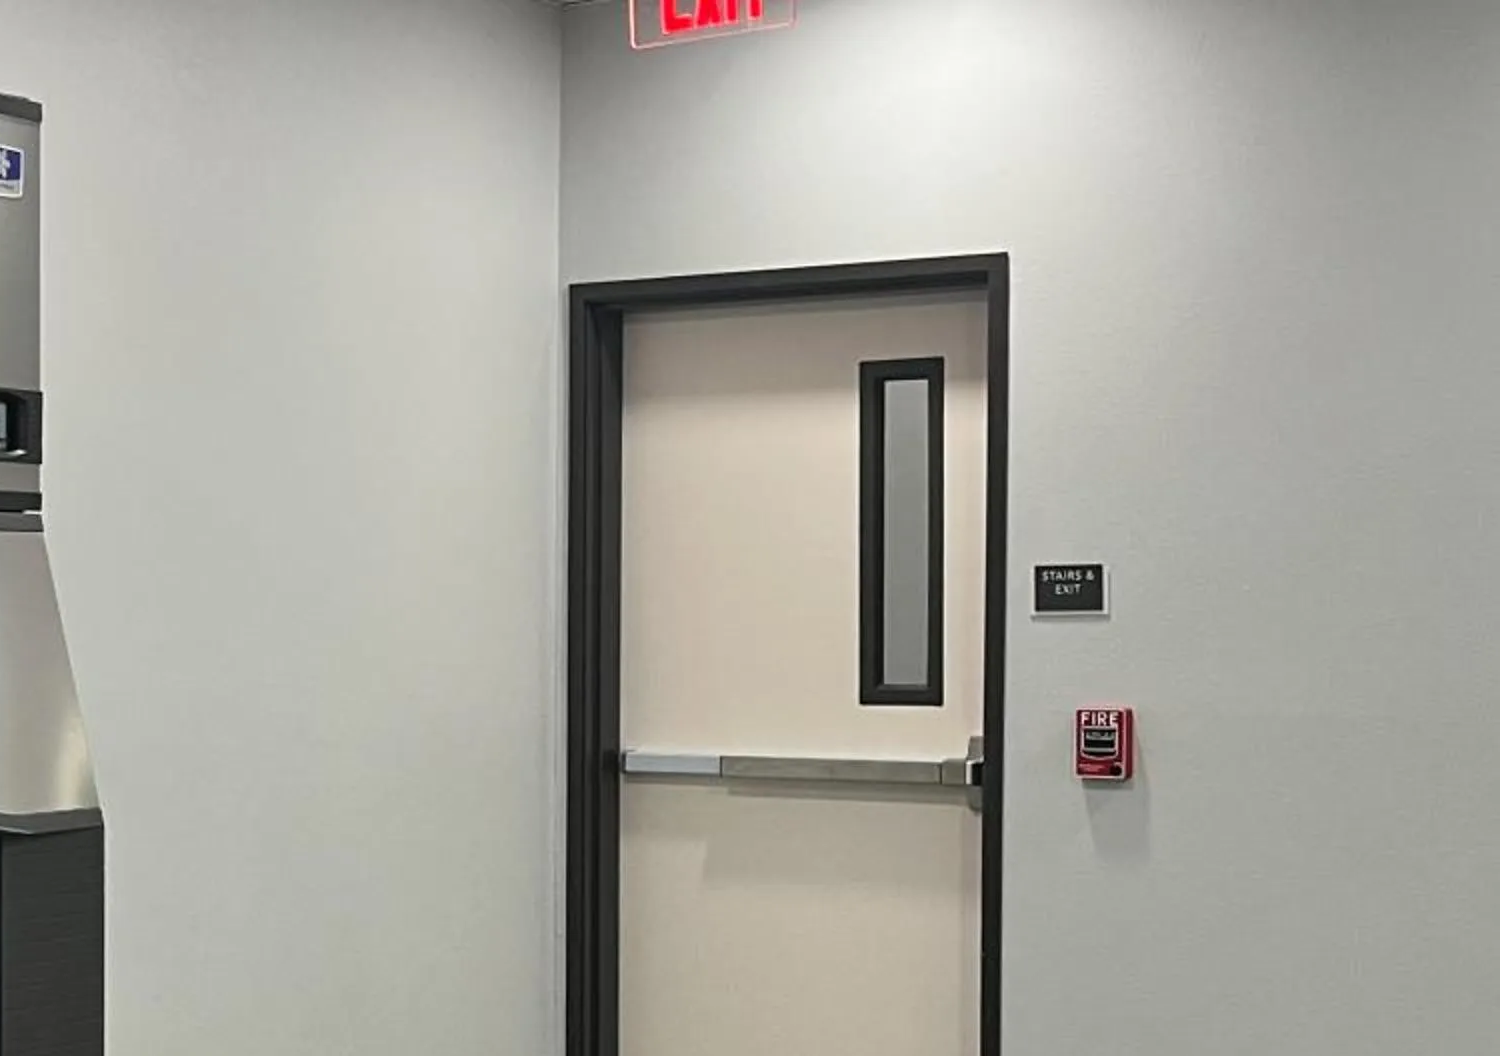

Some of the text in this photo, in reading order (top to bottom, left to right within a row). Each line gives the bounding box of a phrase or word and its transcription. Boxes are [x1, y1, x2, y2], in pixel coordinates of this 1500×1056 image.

[1042, 570, 1082, 582] STAIRS
[1055, 583, 1081, 595] EXIT
[1081, 711, 1119, 726] FIRE
